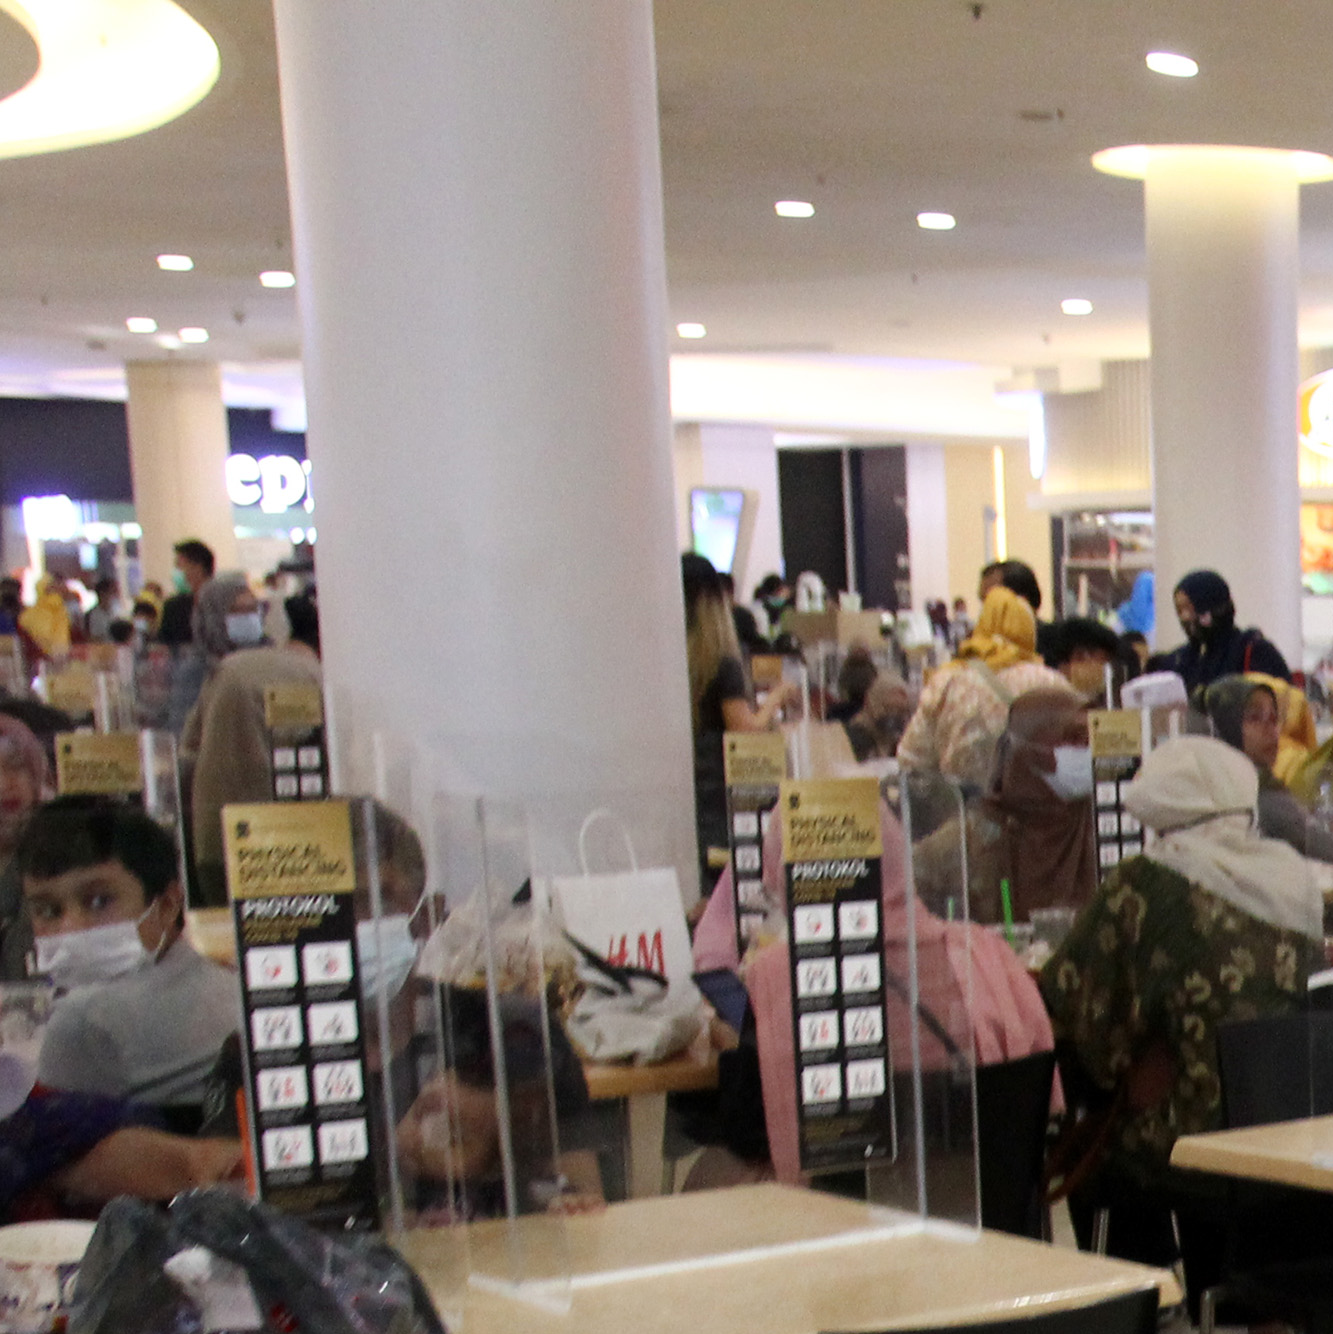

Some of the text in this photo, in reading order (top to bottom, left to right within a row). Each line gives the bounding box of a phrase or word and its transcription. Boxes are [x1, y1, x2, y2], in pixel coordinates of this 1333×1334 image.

[225, 453, 313, 514] ep
[792, 858, 870, 881] PROTOKOL
[241, 893, 341, 919] PROTOKOL
